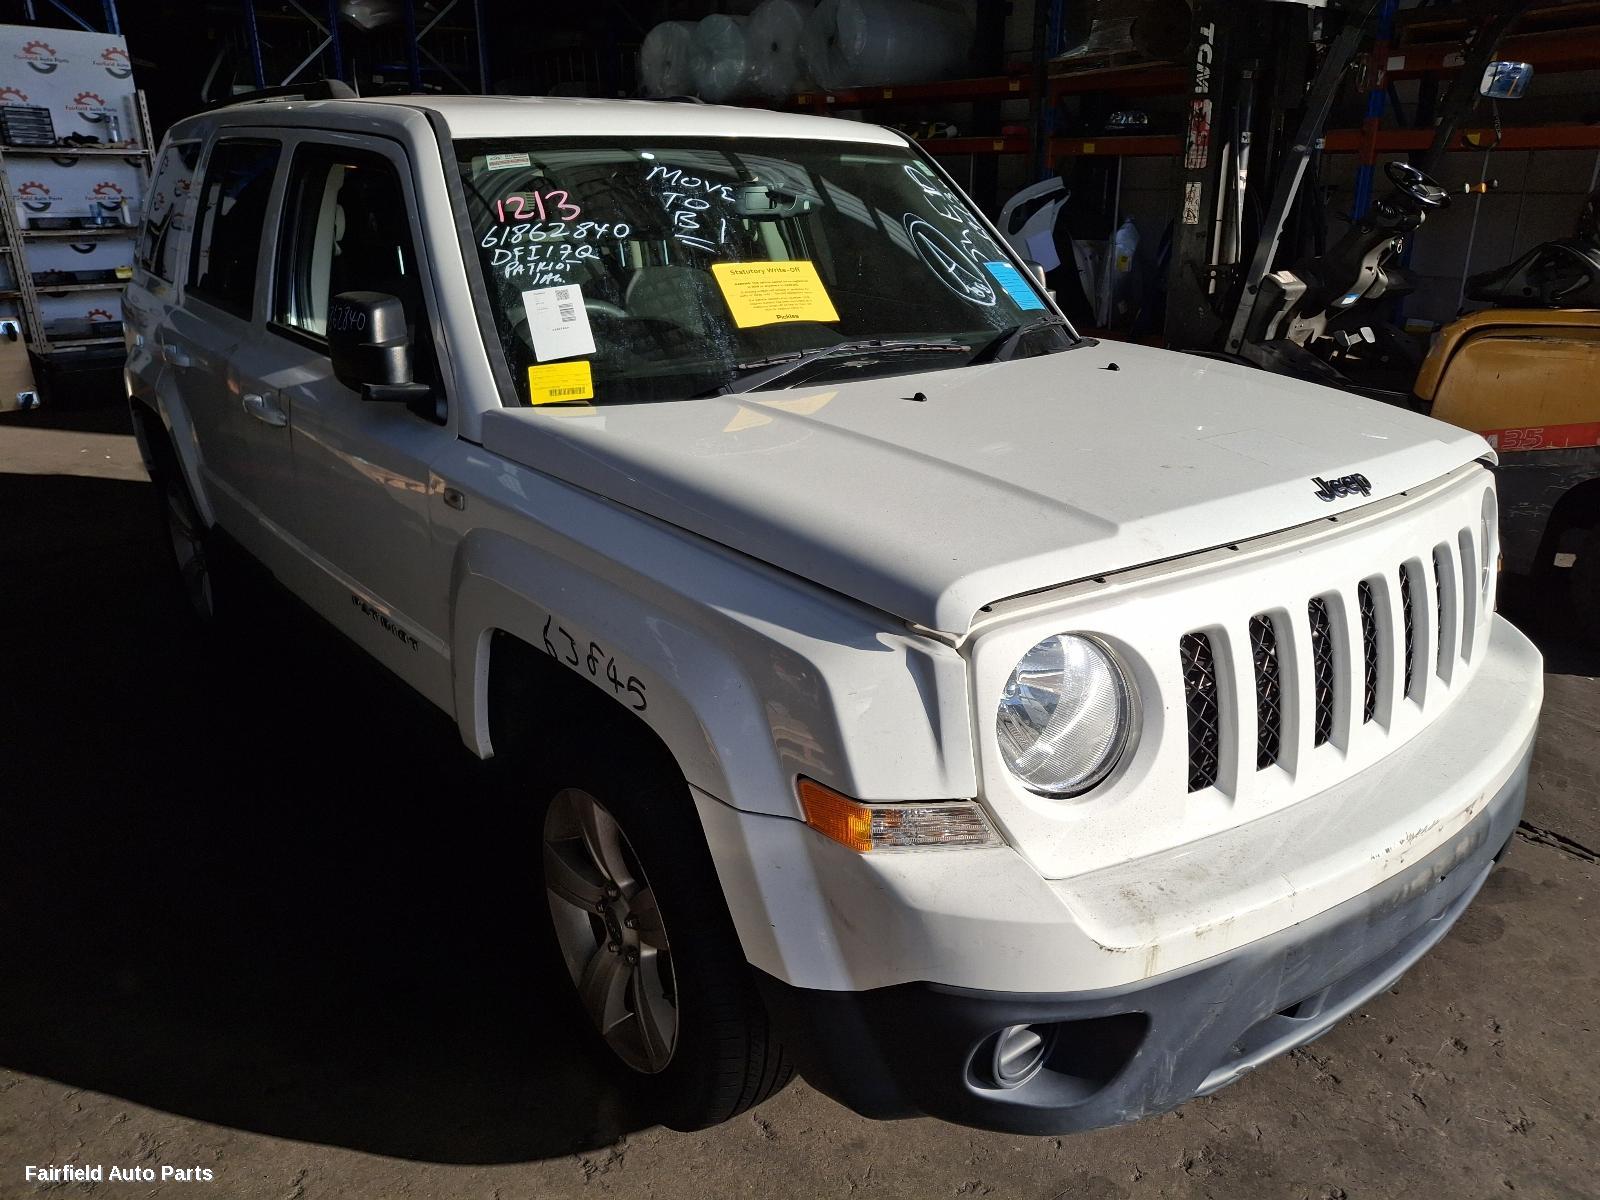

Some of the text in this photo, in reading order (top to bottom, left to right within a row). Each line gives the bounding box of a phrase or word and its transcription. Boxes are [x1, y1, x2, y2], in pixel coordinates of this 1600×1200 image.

[1195, 21, 1215, 94] TCM
[645, 165, 736, 203] MOVE
[662, 191, 711, 211] TO
[481, 221, 630, 248] 61862840
[504, 259, 582, 279] PATRIOT
[729, 268, 765, 276] Statutory
[1502, 428, 1545, 450] 35
[1310, 473, 1372, 502] Jeep
